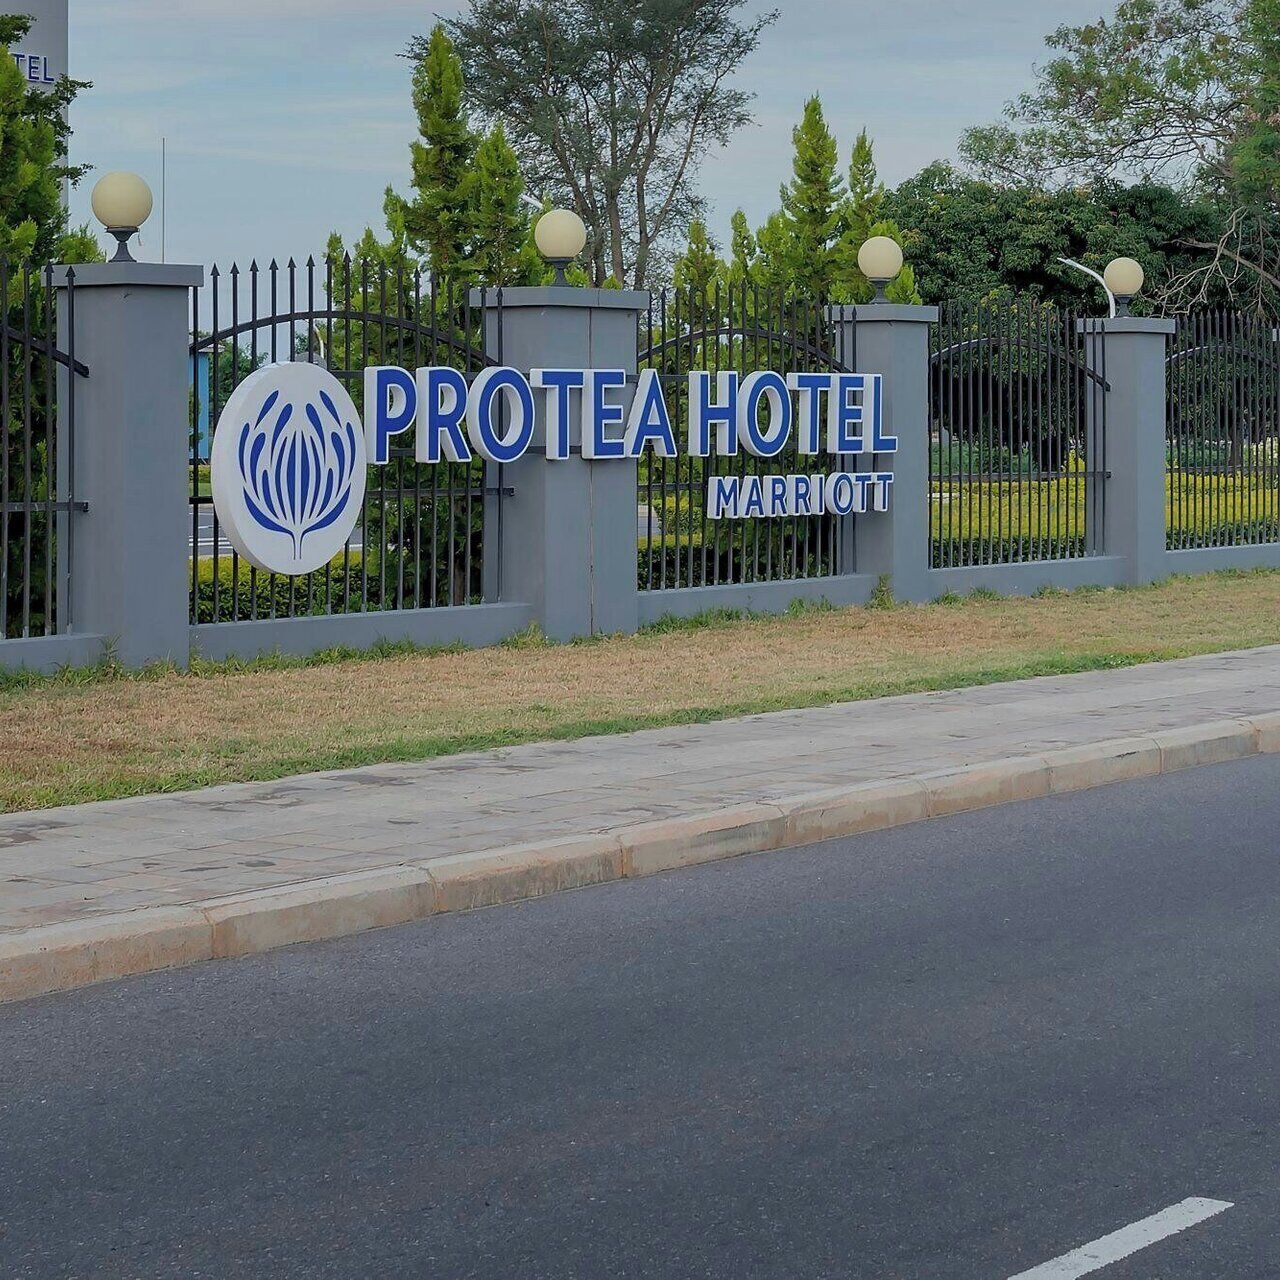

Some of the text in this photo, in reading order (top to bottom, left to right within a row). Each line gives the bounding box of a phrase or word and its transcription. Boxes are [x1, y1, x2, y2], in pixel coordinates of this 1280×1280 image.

[364, 365, 898, 464] PROTEA HOTEL
[706, 472, 894, 519] MARRIOTT
